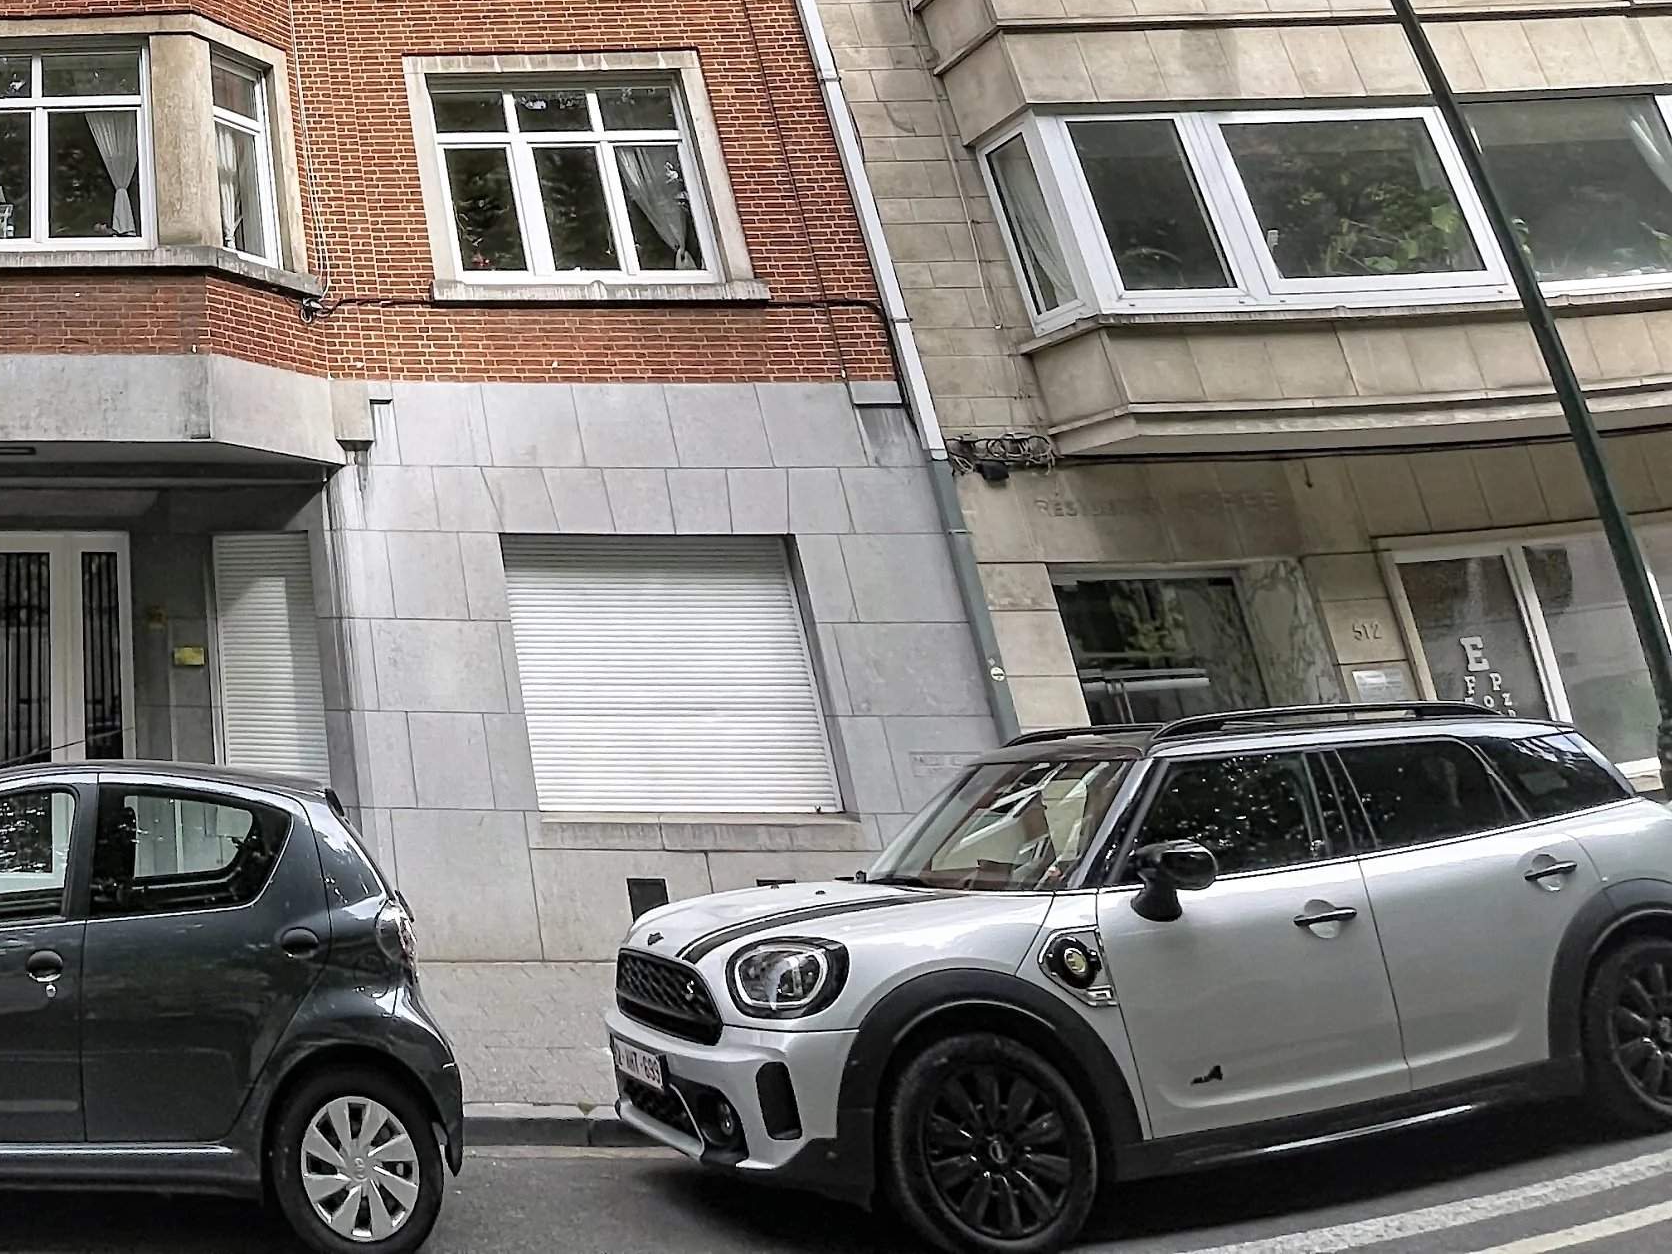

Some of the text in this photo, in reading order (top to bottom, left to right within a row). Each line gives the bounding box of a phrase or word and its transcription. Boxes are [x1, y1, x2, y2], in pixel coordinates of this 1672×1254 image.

[1352, 623, 1383, 641] 512
[1459, 635, 1490, 672] E
[1464, 673, 1502, 695] F P
